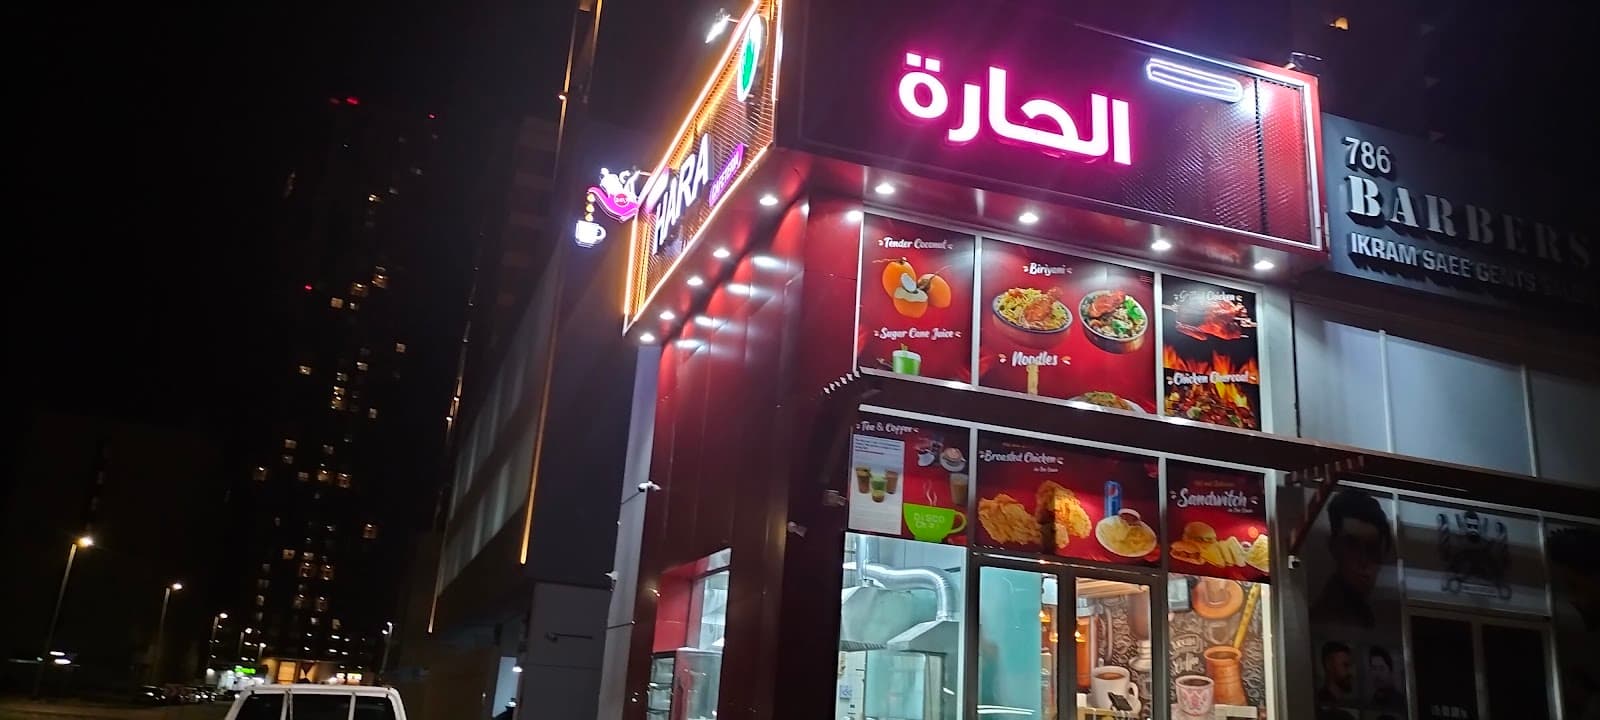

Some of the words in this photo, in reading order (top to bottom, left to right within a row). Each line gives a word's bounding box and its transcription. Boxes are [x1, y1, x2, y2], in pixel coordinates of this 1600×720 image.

[898, 52, 1131, 166] الحارة
[1345, 136, 1392, 174] 786
[652, 132, 711, 256] HARA
[1347, 175, 1592, 272] BARBERS
[883, 236, 913, 249] Tender
[914, 238, 947, 250] Coconut
[1350, 232, 1418, 267] IKRAM
[1029, 262, 1066, 276] Biriyani
[1207, 290, 1235, 302] Chicken
[880, 327, 907, 340] Sugar
[909, 327, 930, 338] Cane
[931, 327, 954, 340] Juice
[1012, 351, 1058, 367] Noodles
[1173, 371, 1208, 385] Chicken
[861, 420, 875, 431] Tea
[984, 449, 1023, 463] Broasted
[1024, 451, 1056, 465] Chicken
[1177, 487, 1247, 508] Sandwitch
